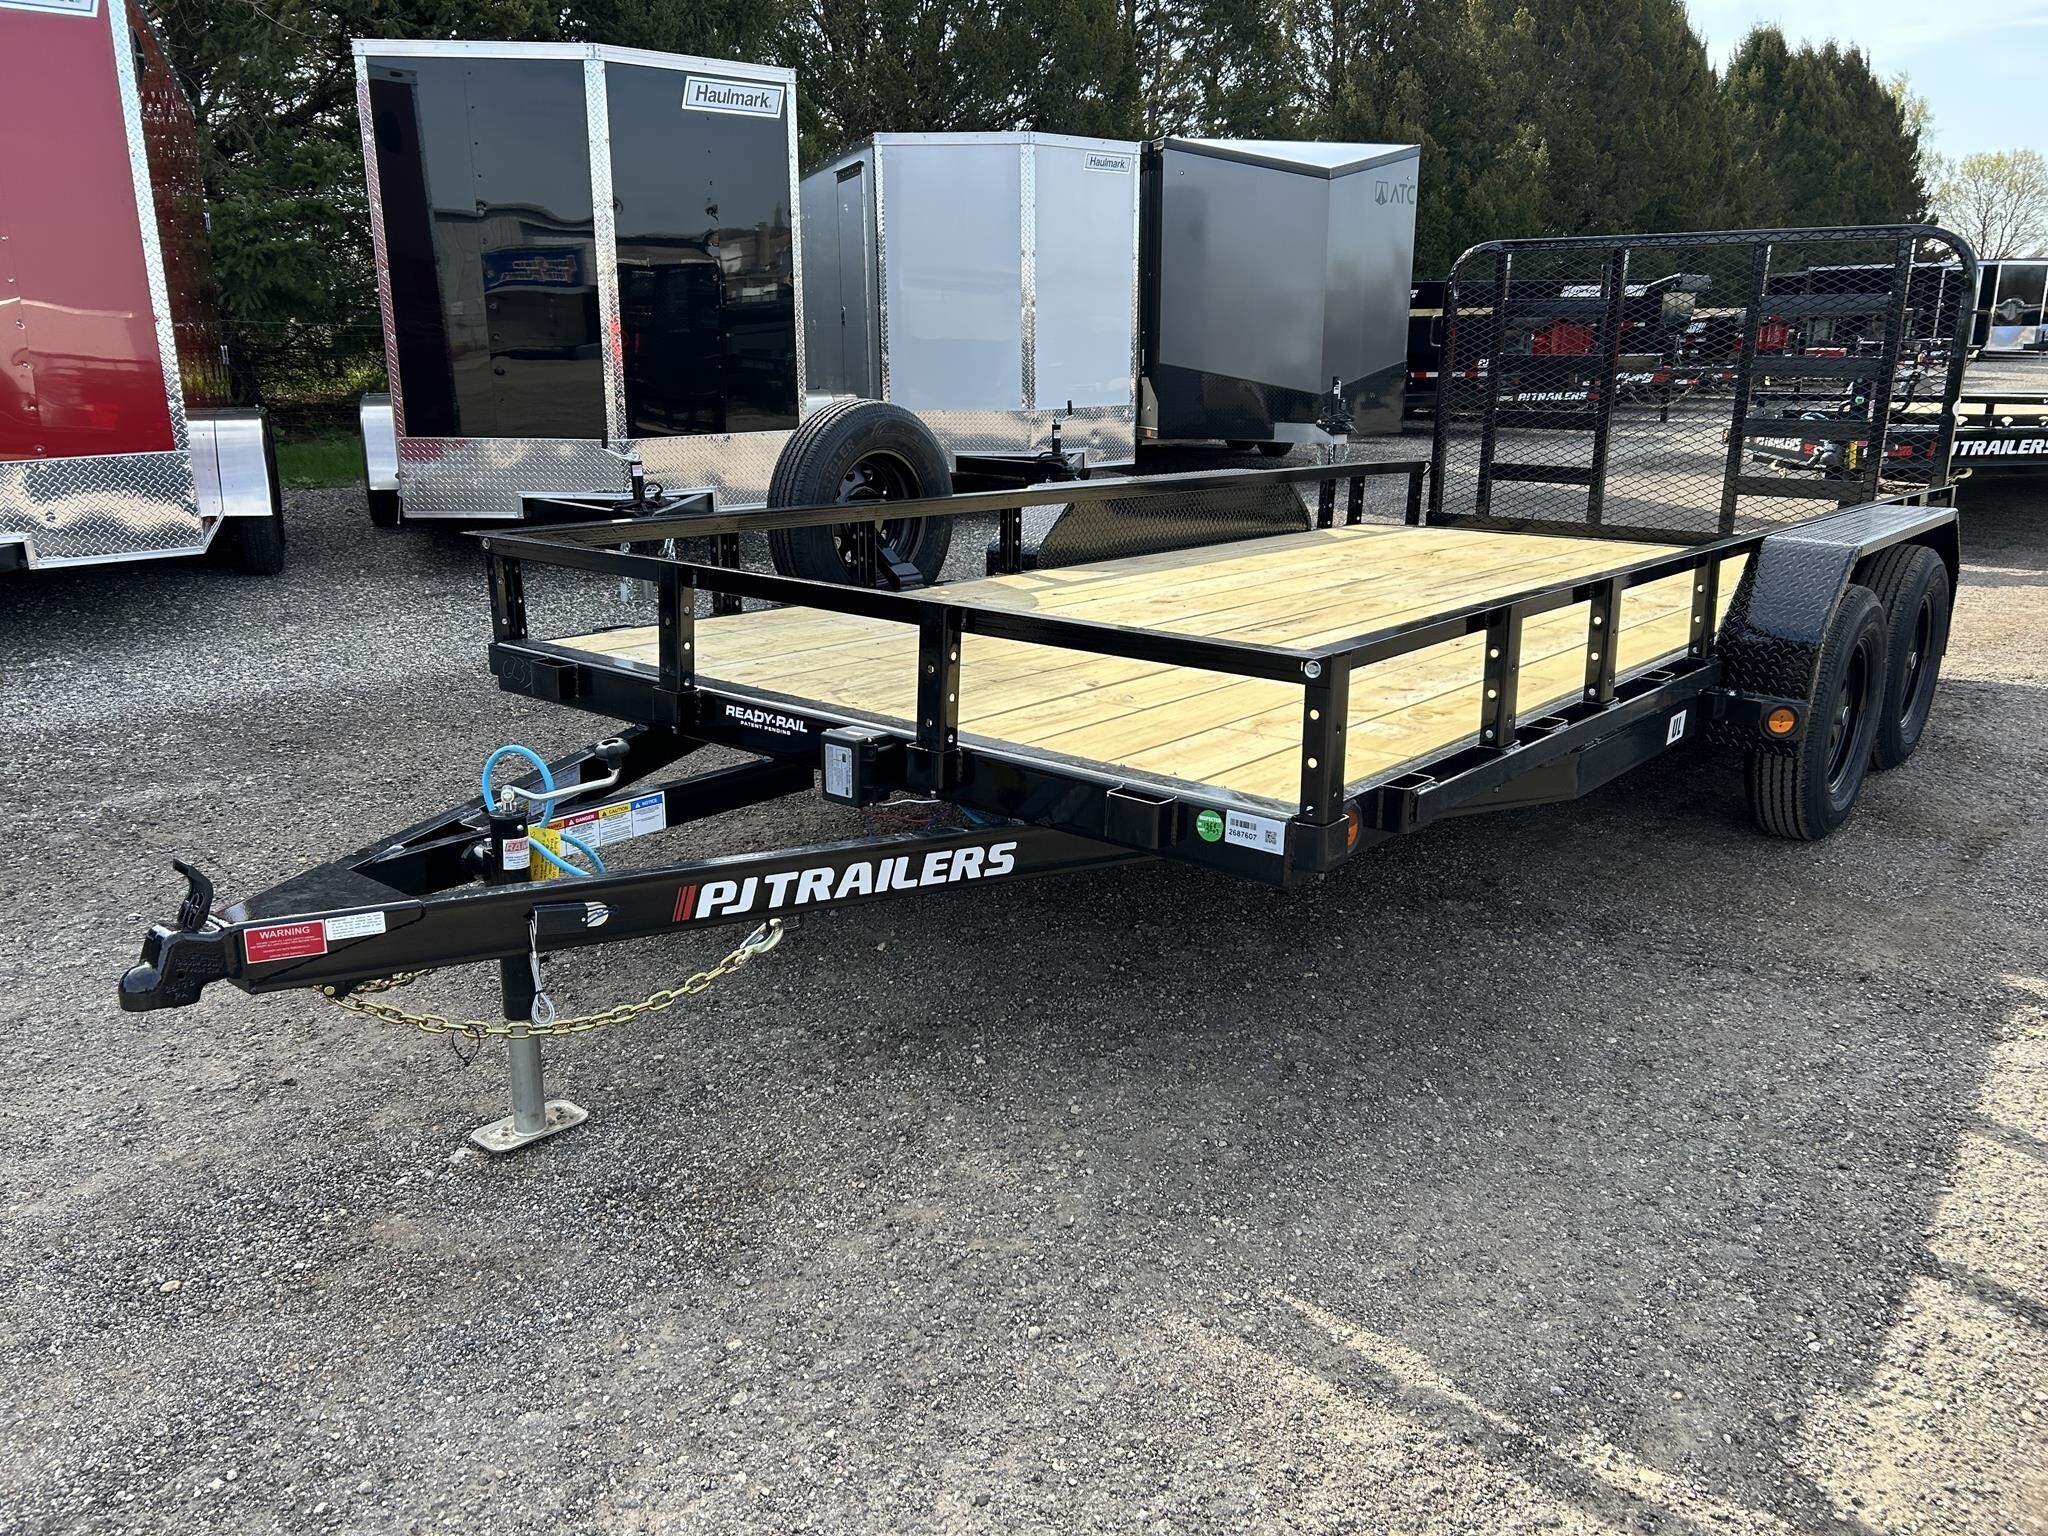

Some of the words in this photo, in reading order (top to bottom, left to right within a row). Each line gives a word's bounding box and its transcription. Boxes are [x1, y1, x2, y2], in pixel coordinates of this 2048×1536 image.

[695, 84, 770, 108] Haulmark
[1089, 156, 1126, 168] Haulmark
[1390, 183, 1416, 205] ATC
[740, 720, 762, 729] PATENT
[764, 725, 791, 735] PENDING
[608, 805, 629, 815] CAUTION
[575, 814, 595, 823] DANGER
[1228, 828, 1257, 841] 2687607
[695, 877, 758, 919] PJ
[764, 841, 1018, 909] TRAILERS
[259, 926, 310, 939] WARNING
